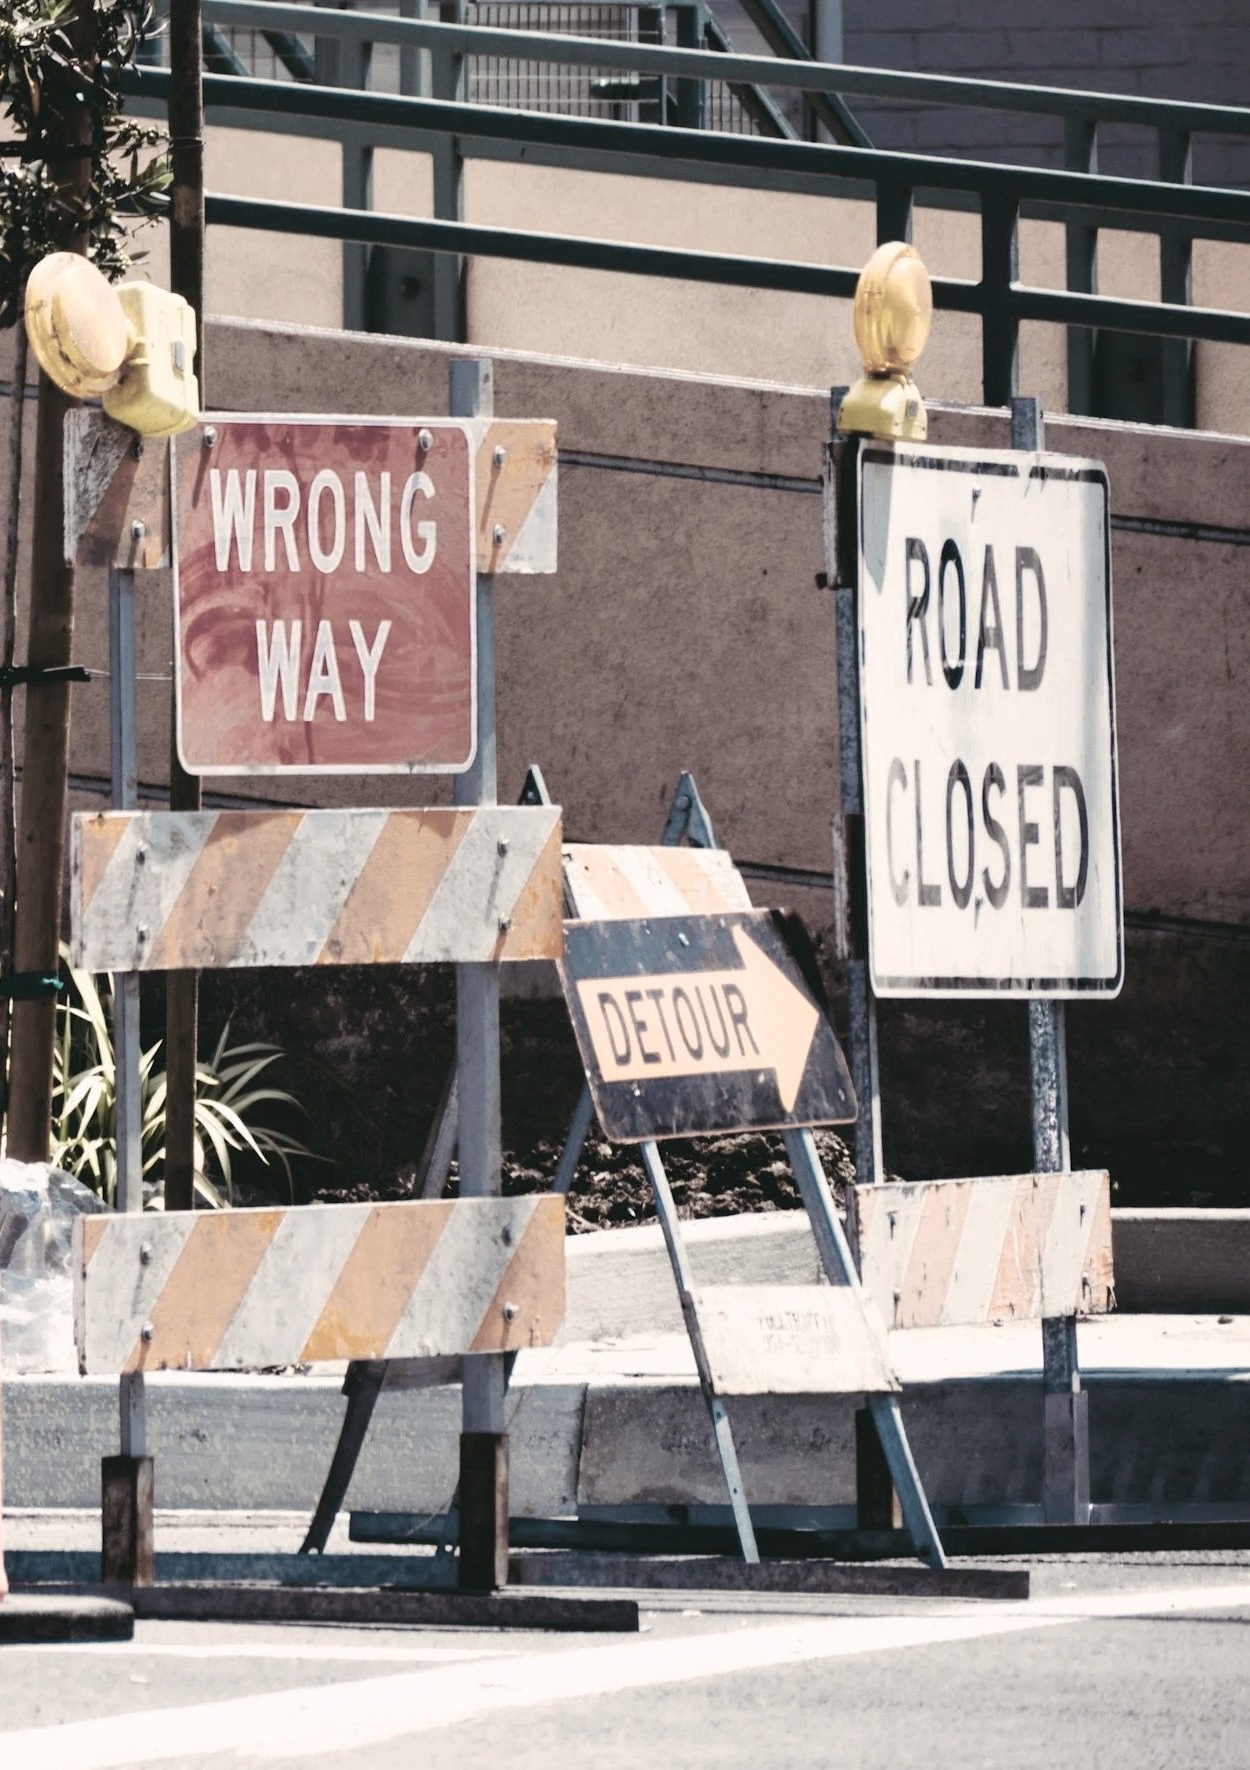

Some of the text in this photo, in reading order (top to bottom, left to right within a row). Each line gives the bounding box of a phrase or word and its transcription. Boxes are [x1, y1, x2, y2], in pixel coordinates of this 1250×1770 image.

[209, 468, 438, 575] WRONG
[904, 536, 1049, 692] ROAD
[255, 619, 393, 722] WAY
[886, 756, 1090, 911] CLOSED
[596, 982, 761, 1067] DETOUR
